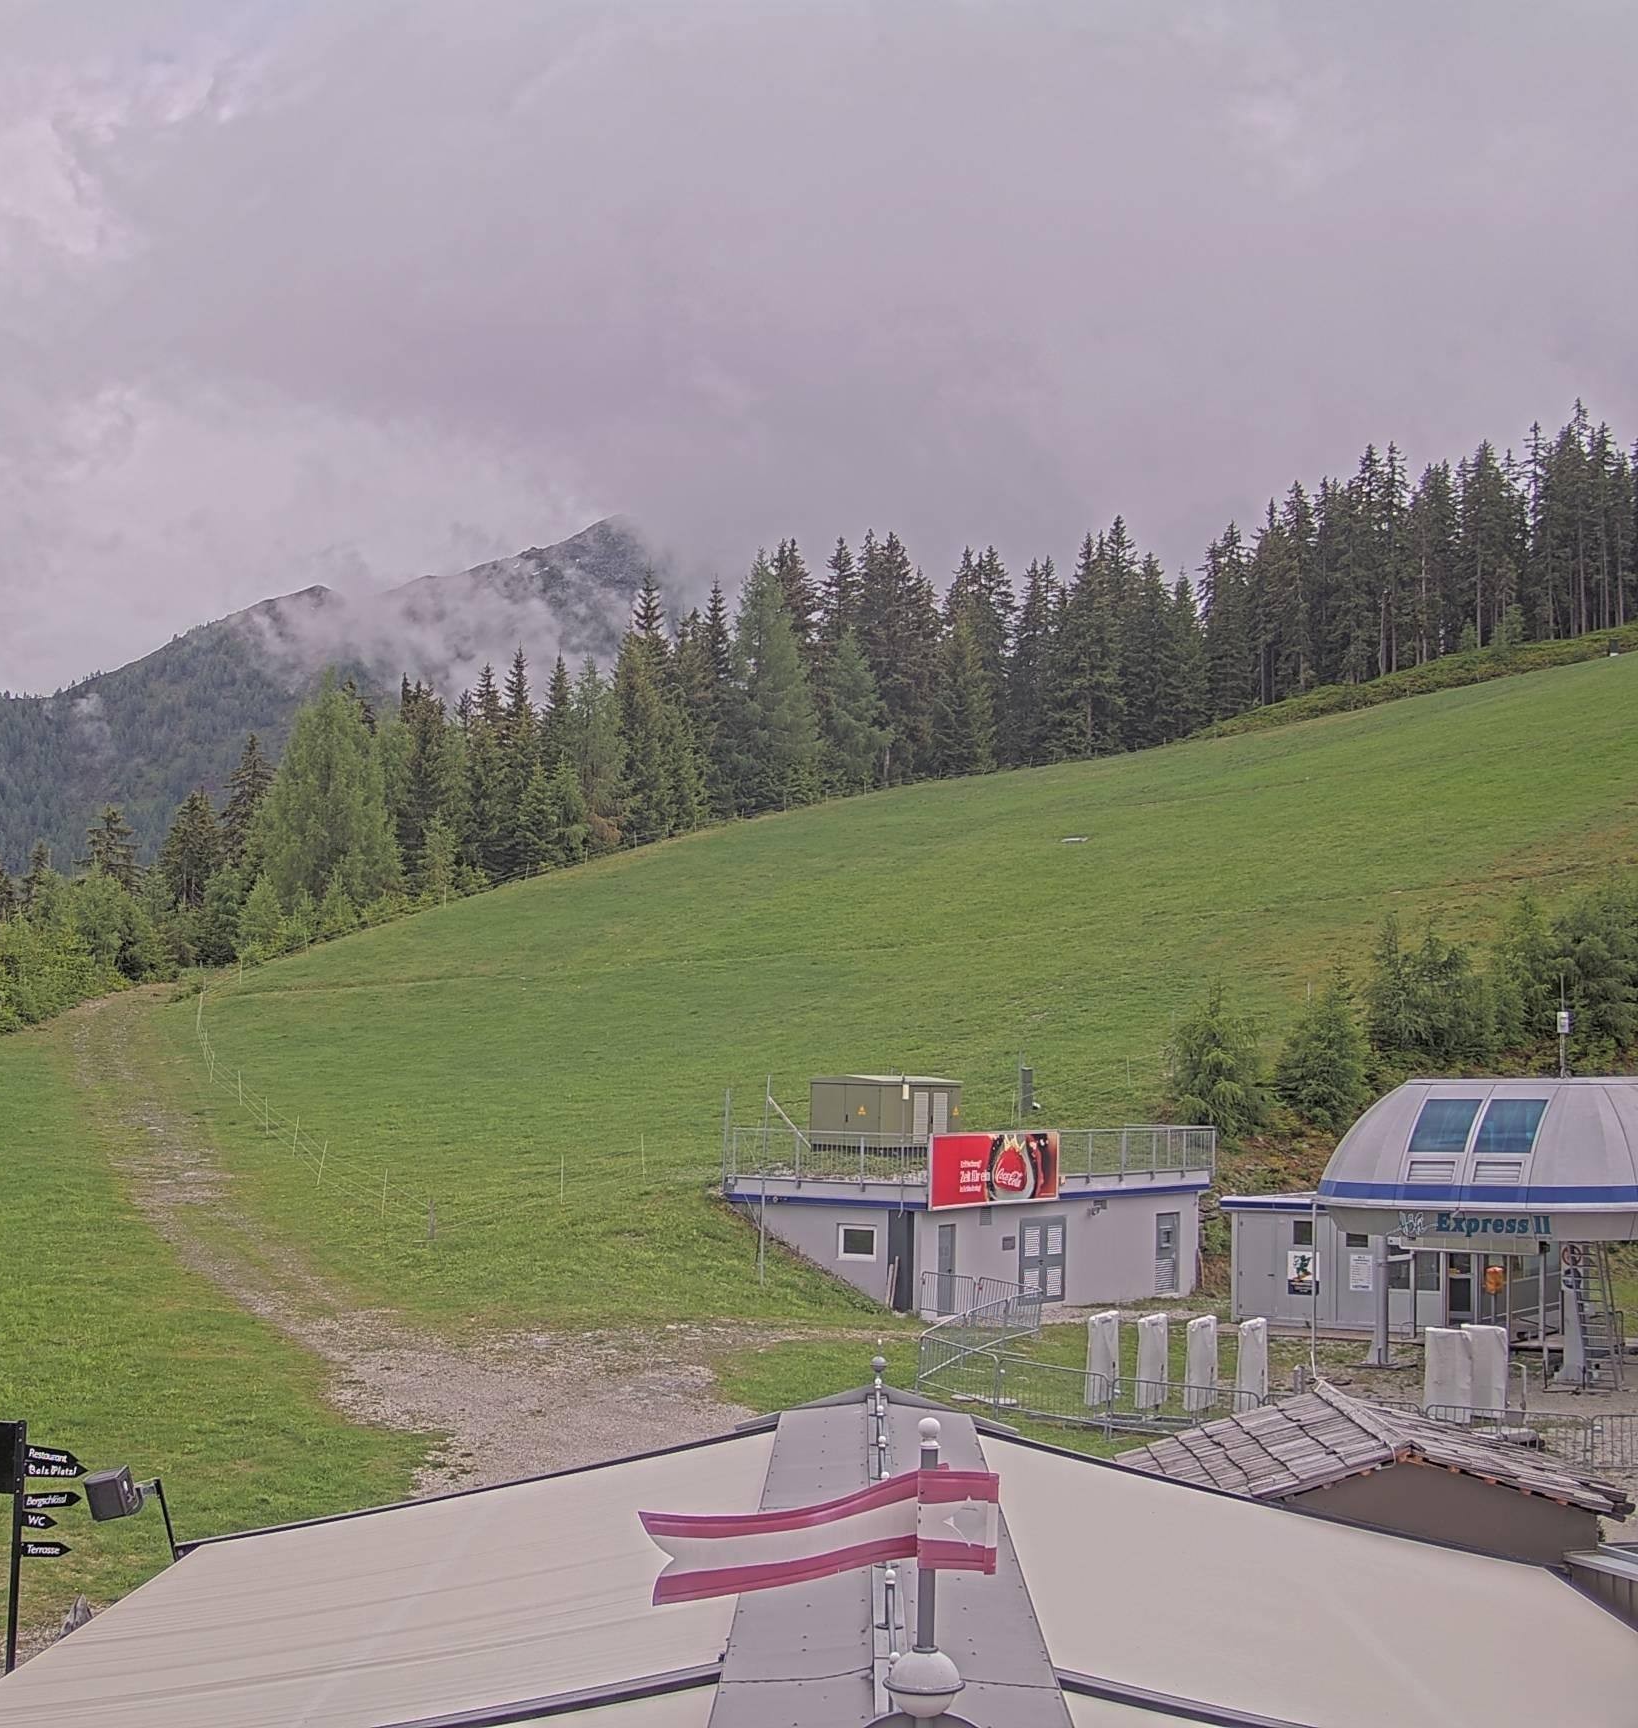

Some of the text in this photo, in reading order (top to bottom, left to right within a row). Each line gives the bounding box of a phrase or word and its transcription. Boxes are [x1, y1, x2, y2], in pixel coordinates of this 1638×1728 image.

[1436, 1212, 1529, 1237] Express
[1533, 1215, 1552, 1235] II
[28, 1448, 68, 1463] Restaurant
[27, 1515, 46, 1526] WC
[27, 1544, 60, 1555] Terrasse
